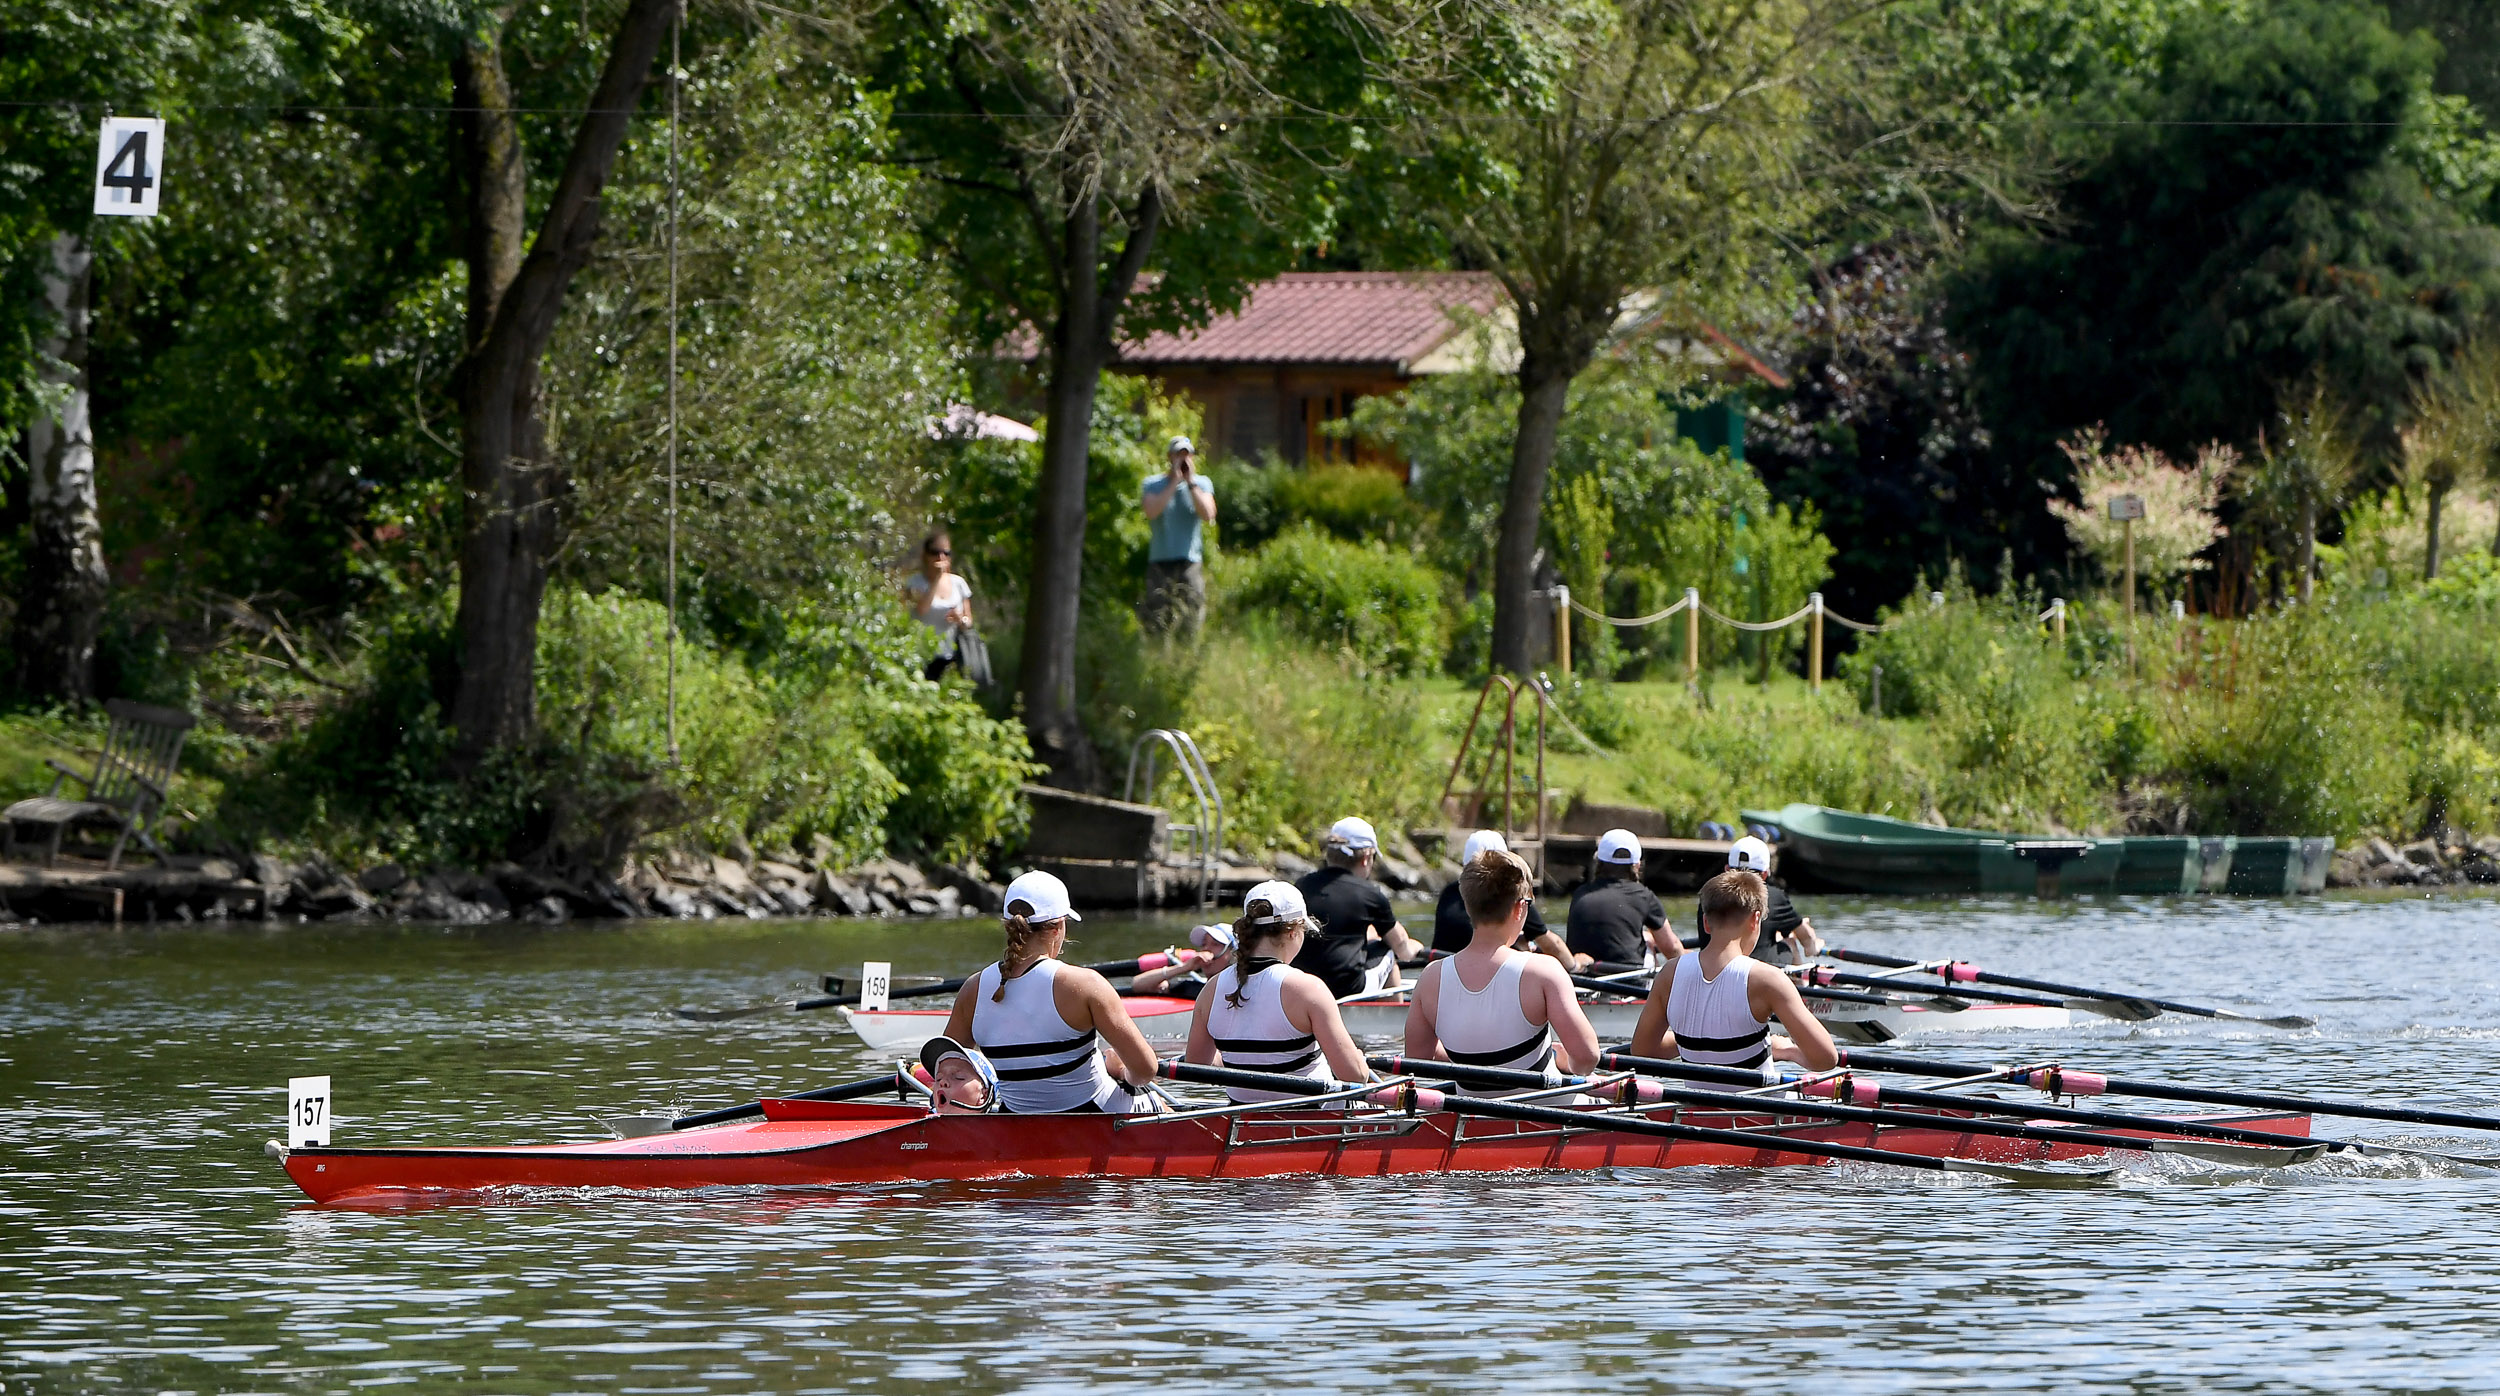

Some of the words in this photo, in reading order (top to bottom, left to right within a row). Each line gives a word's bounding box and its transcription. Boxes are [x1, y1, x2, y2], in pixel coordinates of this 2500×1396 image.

[103, 131, 153, 204] 4
[867, 976, 886, 996] 159
[294, 1096, 324, 1127] 157
[900, 1141, 929, 1151] champion
